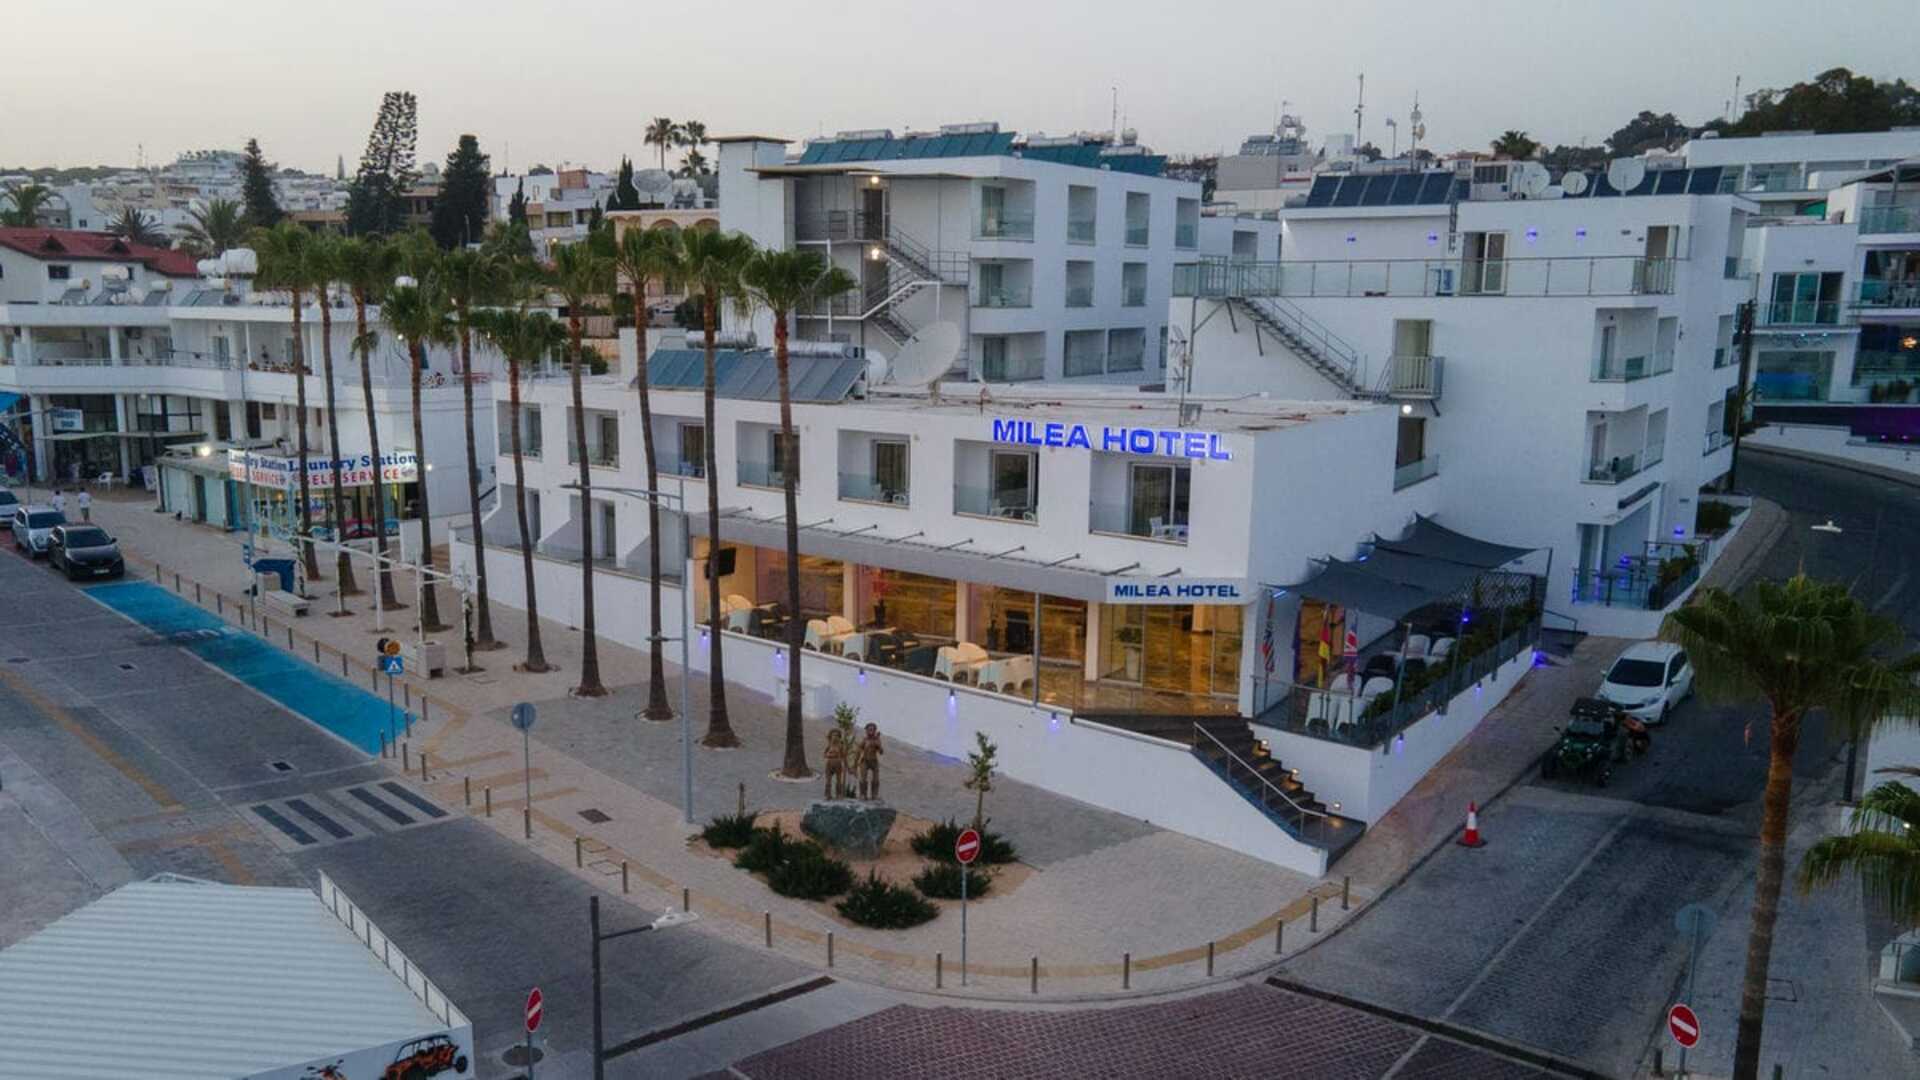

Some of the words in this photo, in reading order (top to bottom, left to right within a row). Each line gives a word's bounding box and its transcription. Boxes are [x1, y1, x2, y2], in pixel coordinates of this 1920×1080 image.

[993, 419, 1090, 449] MILEA
[1103, 427, 1229, 460] HOTEL
[361, 453, 419, 467] Sation
[343, 468, 399, 484] SERVCE
[1114, 584, 1171, 597] MILEA
[1177, 584, 1240, 597] HOTEL
